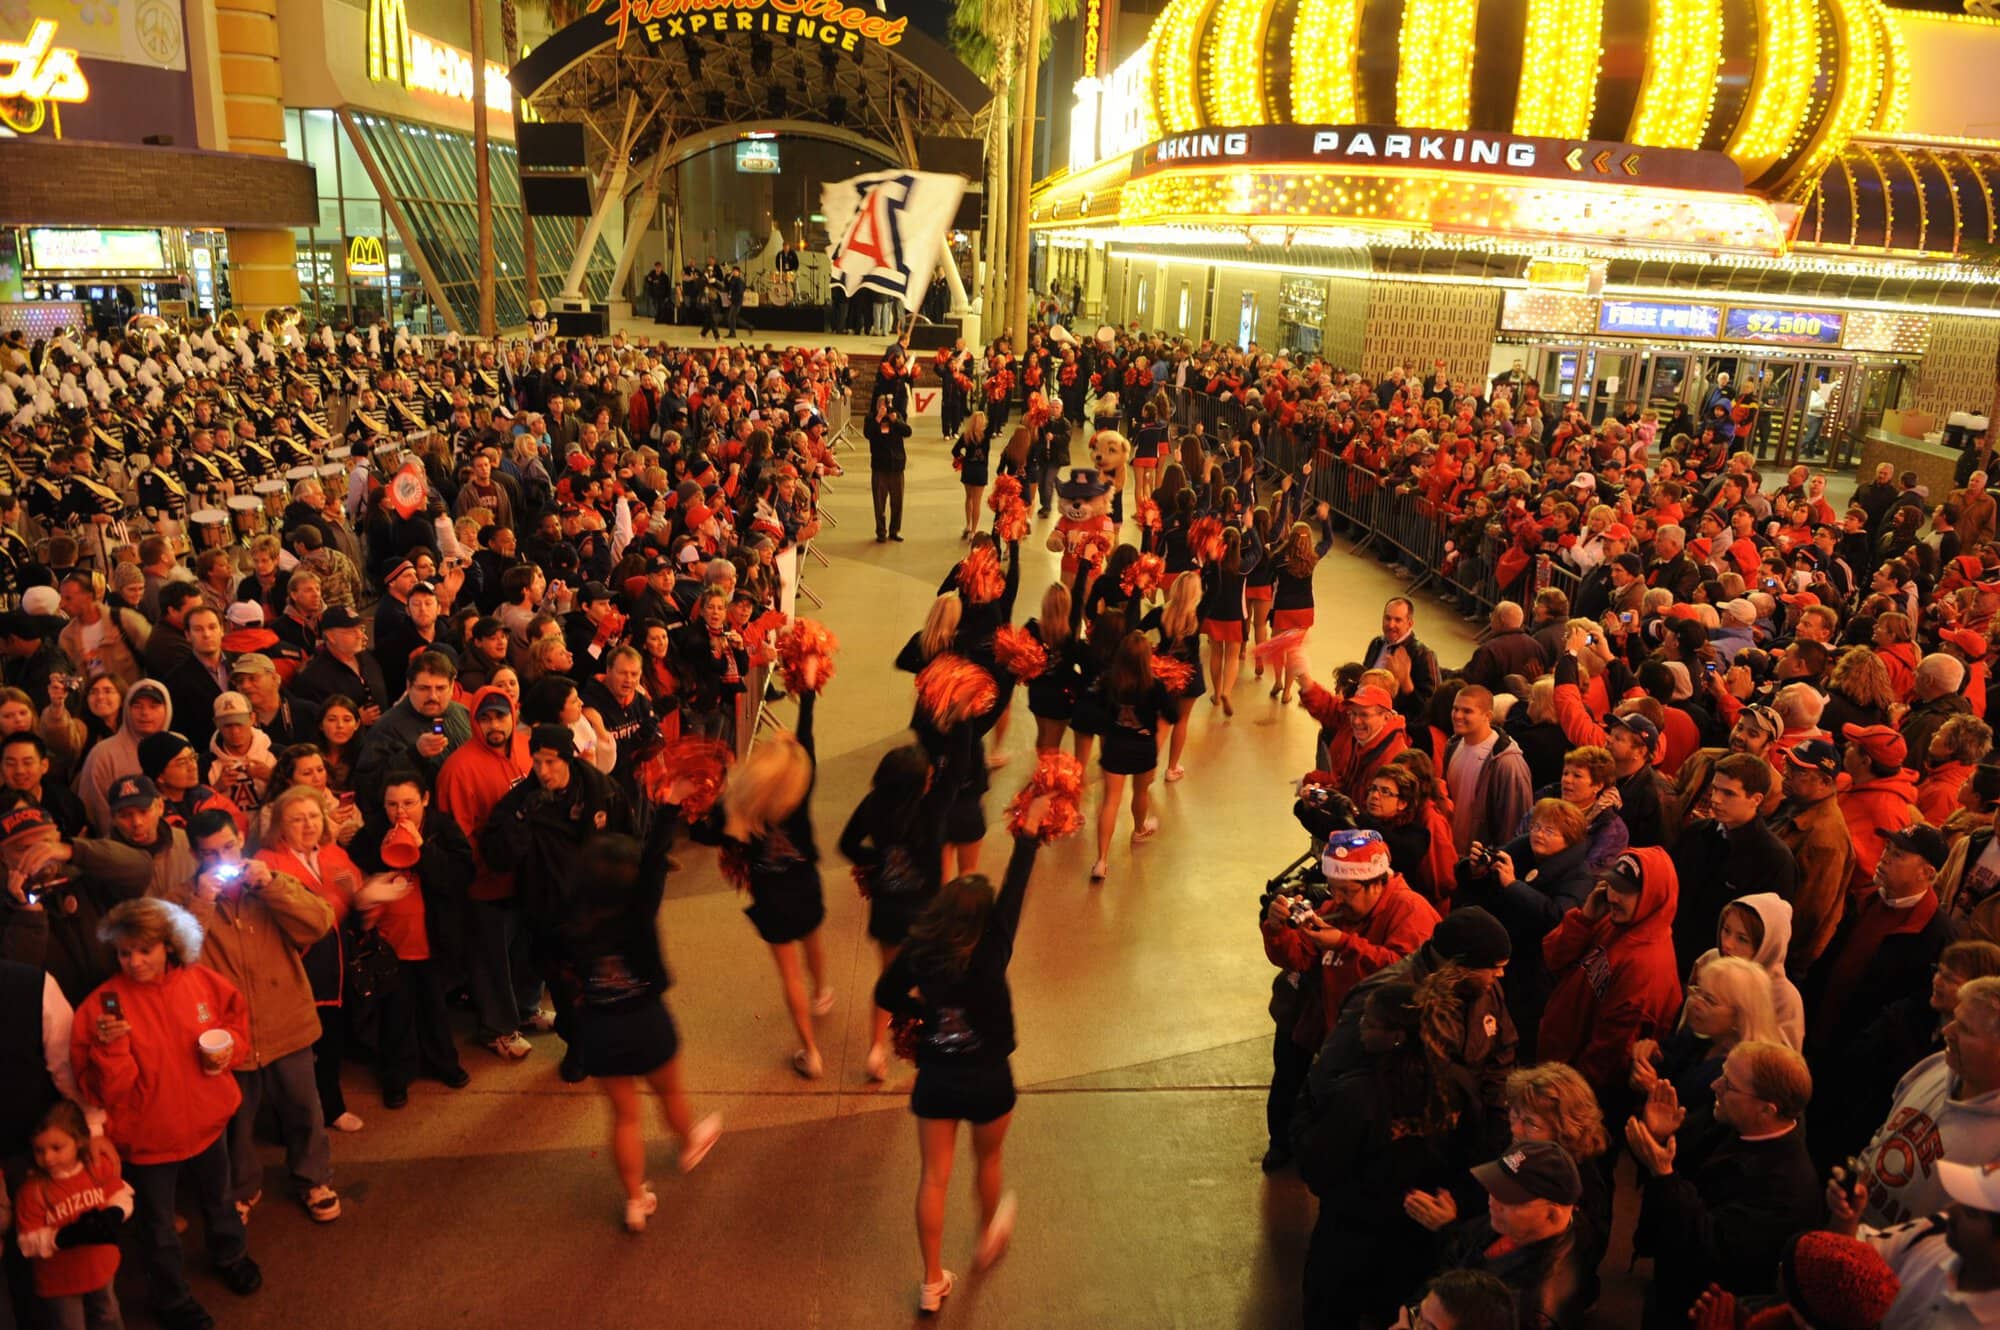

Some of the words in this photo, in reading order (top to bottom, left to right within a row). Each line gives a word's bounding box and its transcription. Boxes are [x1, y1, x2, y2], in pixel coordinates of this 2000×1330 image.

[646, 12, 859, 52] EXPERIENCE
[1313, 132, 1536, 167] PARKING
[831, 175, 915, 294] A
[1608, 306, 1658, 326] FREE
[1747, 313, 1821, 336] $2,500
